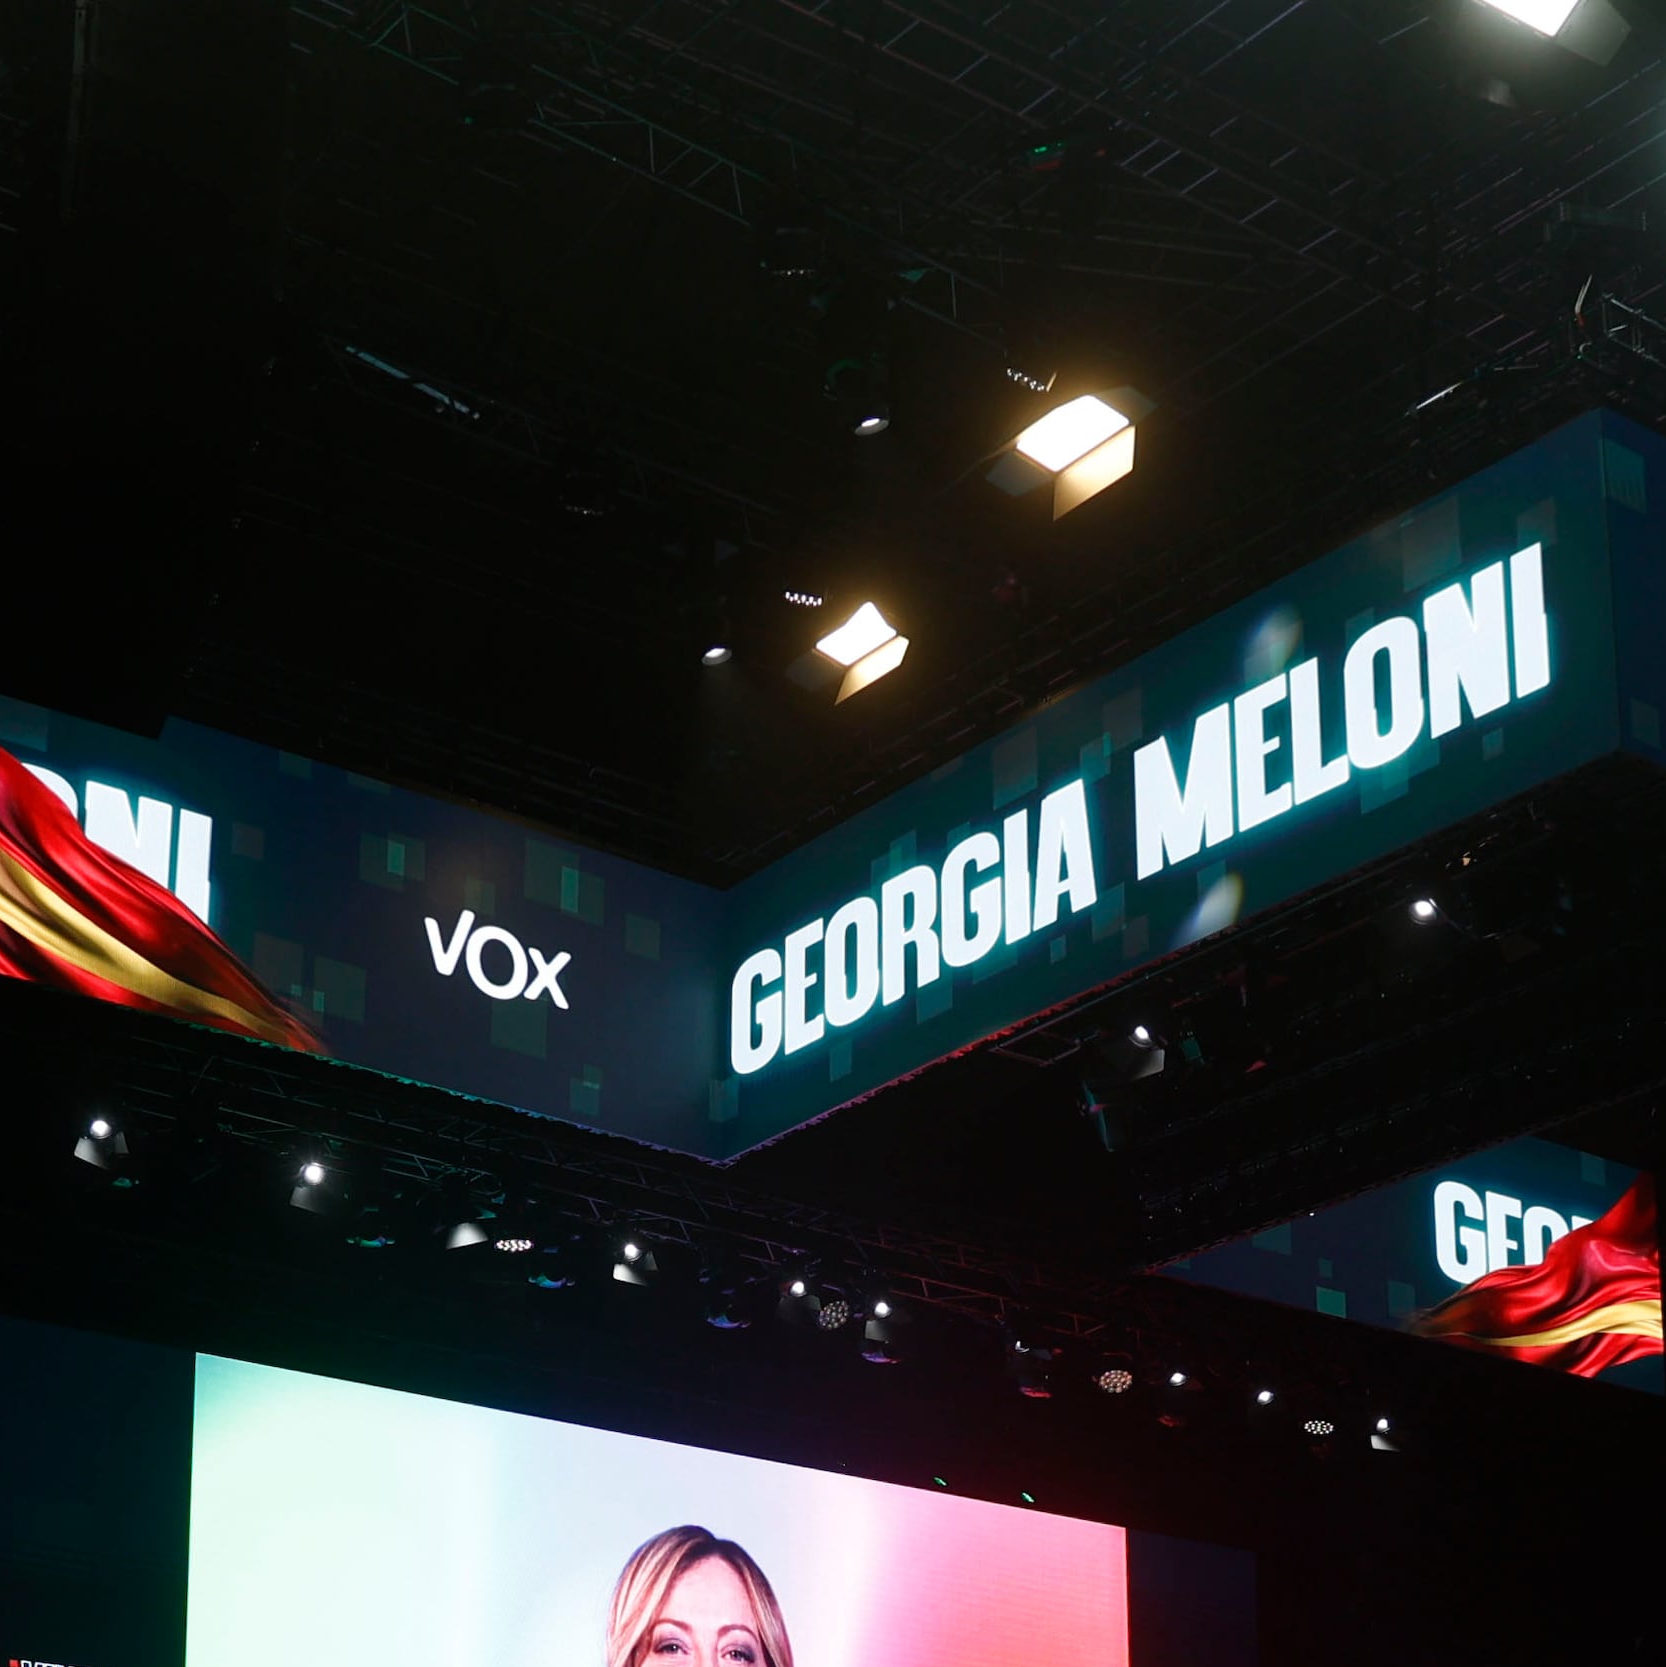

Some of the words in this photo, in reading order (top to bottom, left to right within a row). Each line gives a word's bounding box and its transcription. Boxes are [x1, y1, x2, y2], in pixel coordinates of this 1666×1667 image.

[423, 908, 573, 1011] VOX
[730, 777, 1098, 1076] GEORGIA
[1132, 541, 1551, 882] MELONI
